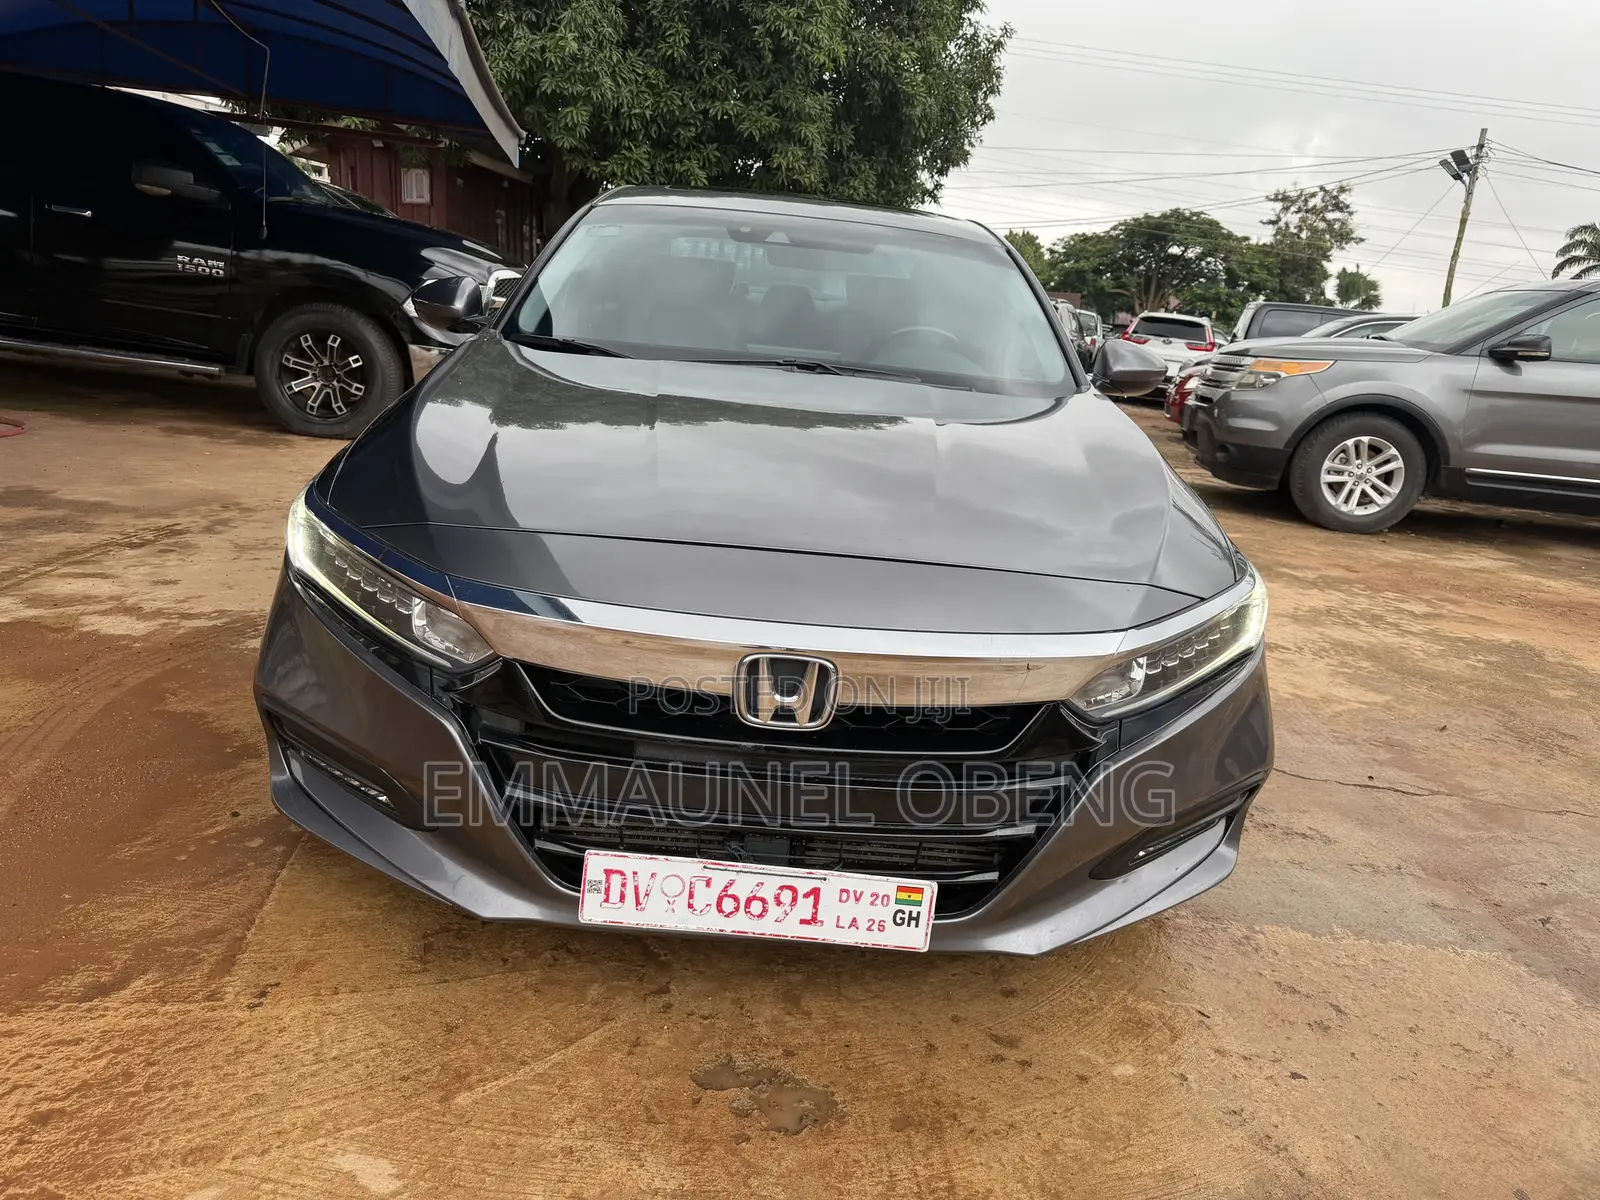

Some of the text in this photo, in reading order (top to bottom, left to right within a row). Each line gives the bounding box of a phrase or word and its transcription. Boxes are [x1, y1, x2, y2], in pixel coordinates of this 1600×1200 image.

[176, 254, 225, 269] RAM
[176, 262, 225, 277] 1500
[600, 868, 657, 912] DV
[687, 875, 824, 927] C6691
[838, 888, 891, 907] DV 20
[835, 915, 887, 932] LA 26
[892, 908, 921, 928] GH
